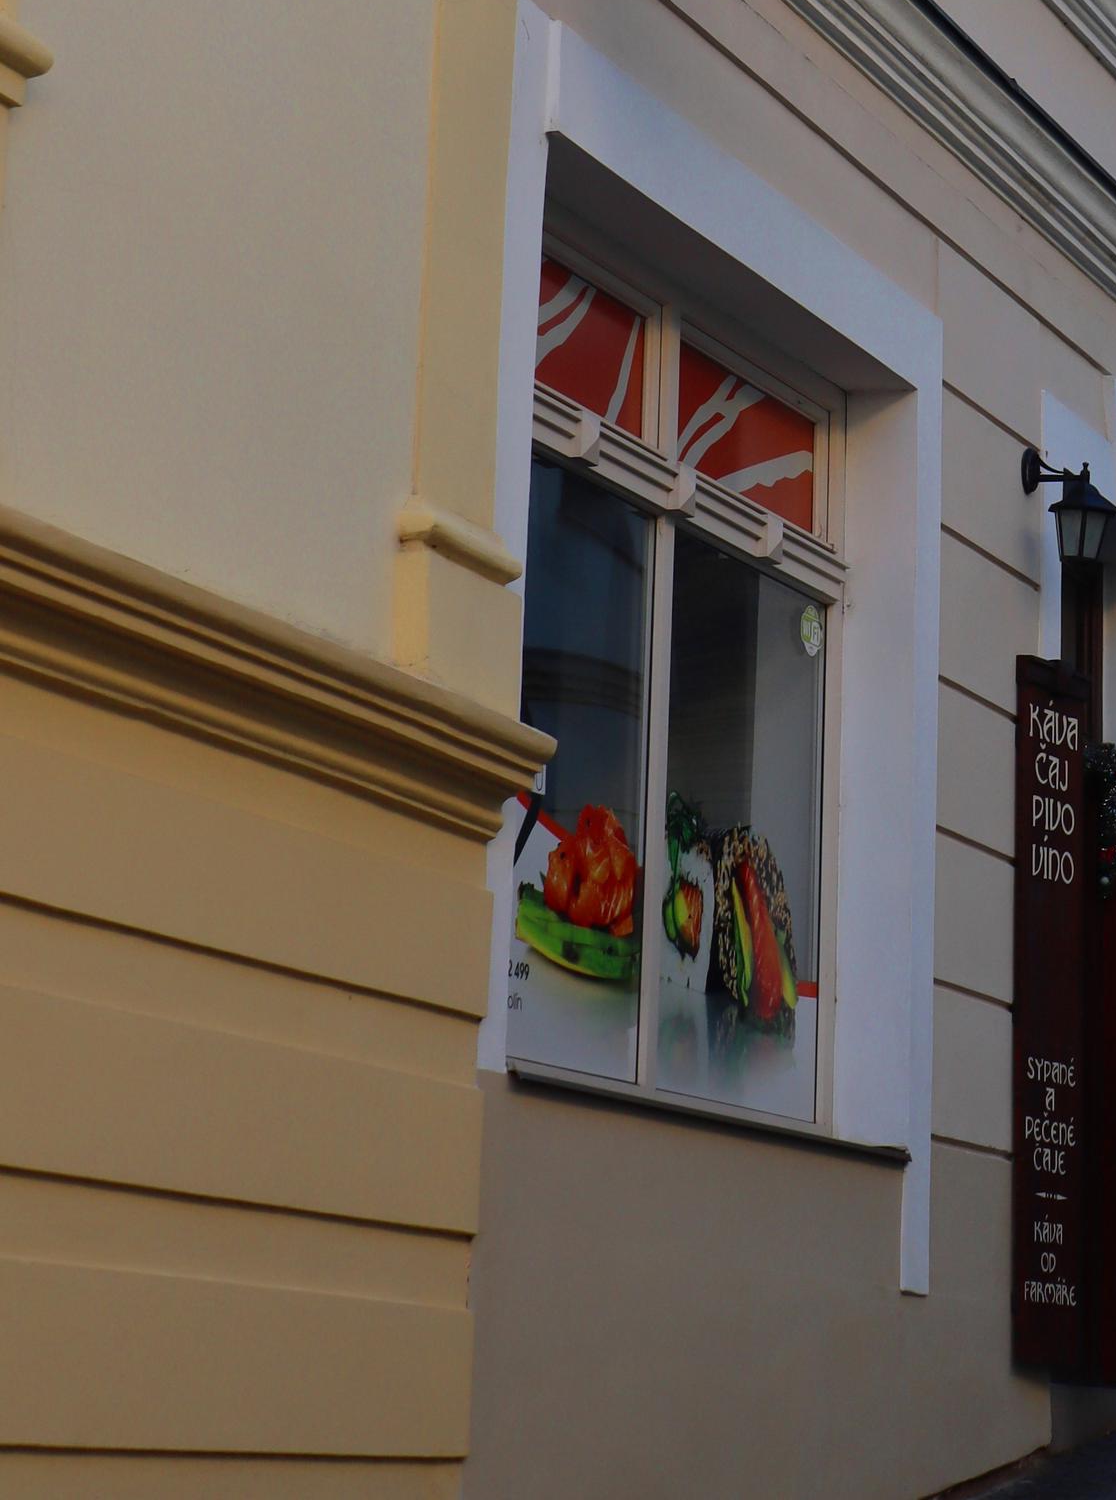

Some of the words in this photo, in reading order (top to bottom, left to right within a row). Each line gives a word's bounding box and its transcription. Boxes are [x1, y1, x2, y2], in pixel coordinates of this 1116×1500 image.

[1028, 699, 1079, 752] KÁVA
[1034, 742, 1070, 792] ČAJ
[1031, 795, 1076, 835] PIVO
[1031, 835, 1075, 884] VÍNO
[1027, 1057, 1076, 1088] SYPANÉ
[1044, 1087, 1056, 1112] A
[1025, 1111, 1076, 1148] PEČENÉ
[1033, 1142, 1067, 1176] ČAJE
[1033, 1214, 1064, 1246] KÁVA
[1040, 1252, 1057, 1273] OD
[1024, 1276, 1078, 1307] FARMÁŘE
